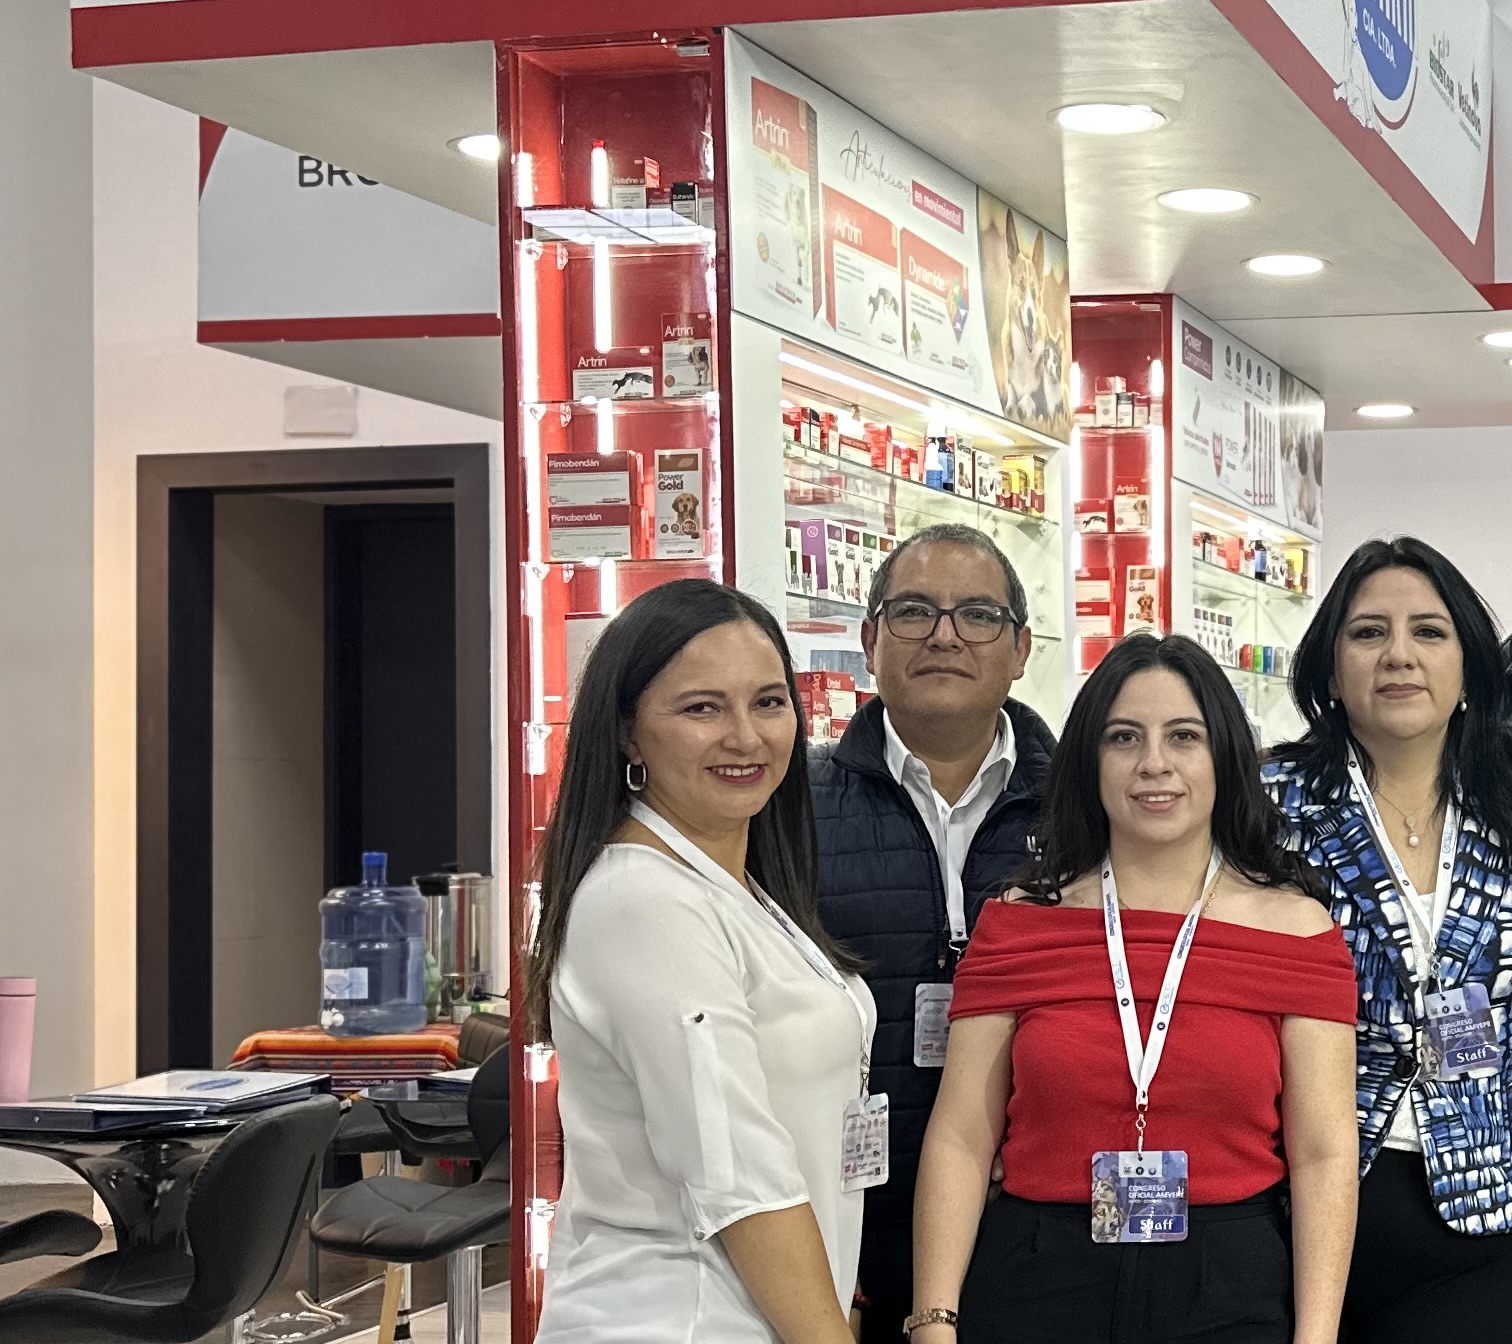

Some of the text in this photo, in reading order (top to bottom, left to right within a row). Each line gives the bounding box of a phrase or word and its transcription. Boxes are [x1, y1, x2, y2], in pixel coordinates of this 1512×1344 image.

[754, 109, 790, 150] Artrin
[834, 214, 863, 247] Artrin
[664, 325, 695, 338] Artrin
[577, 356, 608, 368] Artrin
[658, 481, 684, 491] Gold
[1456, 1047, 1487, 1063] Staff
